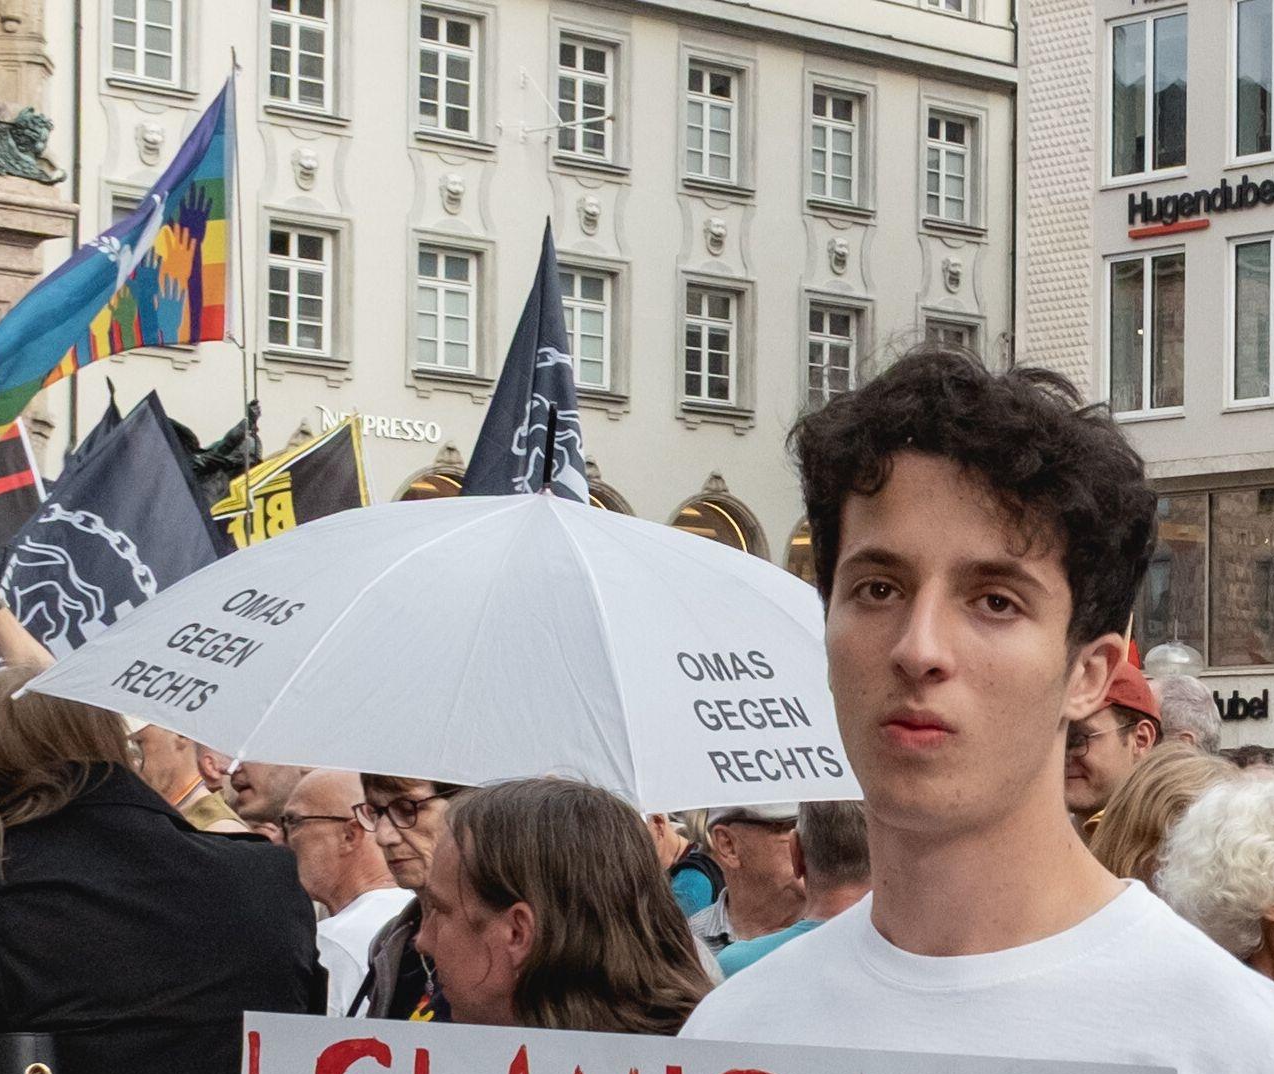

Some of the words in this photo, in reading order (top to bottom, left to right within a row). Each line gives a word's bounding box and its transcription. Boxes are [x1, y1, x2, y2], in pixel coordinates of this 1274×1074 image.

[222, 589, 305, 626] OMAS
[167, 622, 264, 668] GEGEN
[677, 650, 775, 681] OMAS
[111, 659, 219, 712] RECHTS
[693, 697, 813, 731] GEGEN
[707, 746, 844, 783] RECHTS
